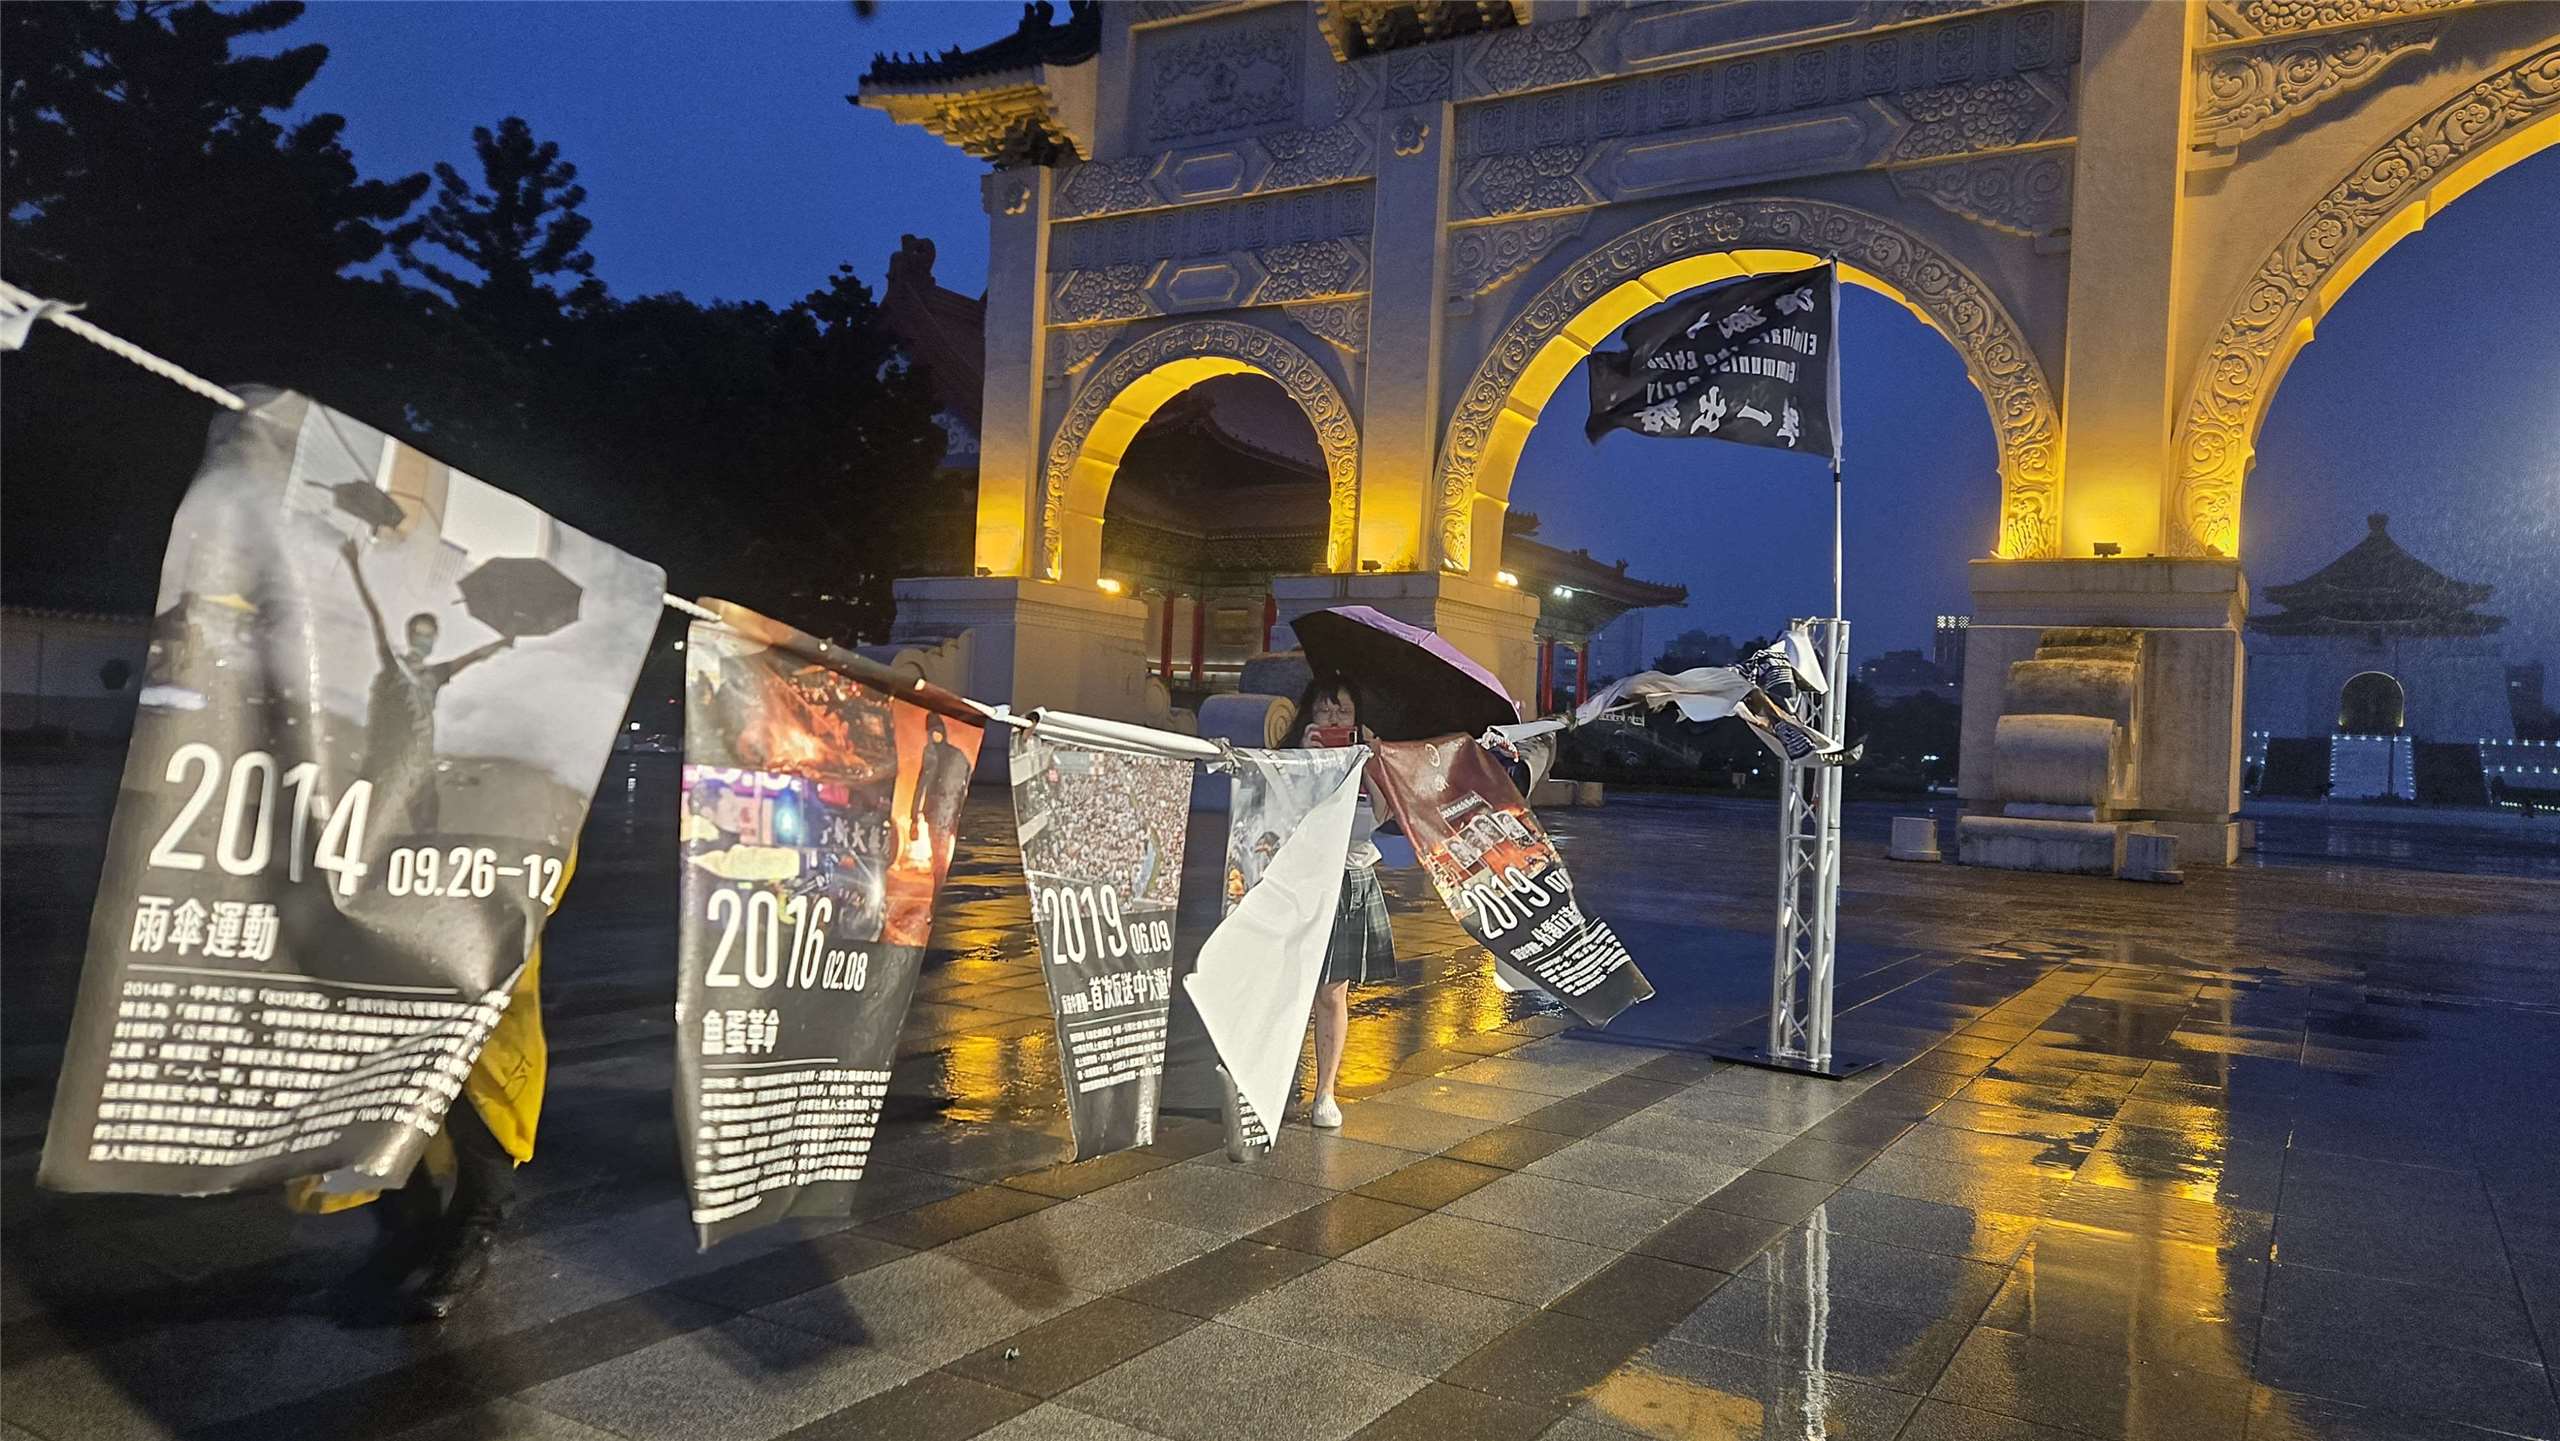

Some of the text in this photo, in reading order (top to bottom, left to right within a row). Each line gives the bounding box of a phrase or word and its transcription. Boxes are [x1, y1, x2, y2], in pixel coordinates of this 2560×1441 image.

[150, 743, 374, 896] 2014
[130, 894, 281, 962] 雨傘運動
[705, 889, 869, 991] 2016 02.08
[1042, 884, 1172, 965] 2019 06.09
[1461, 865, 1551, 940] 2019
